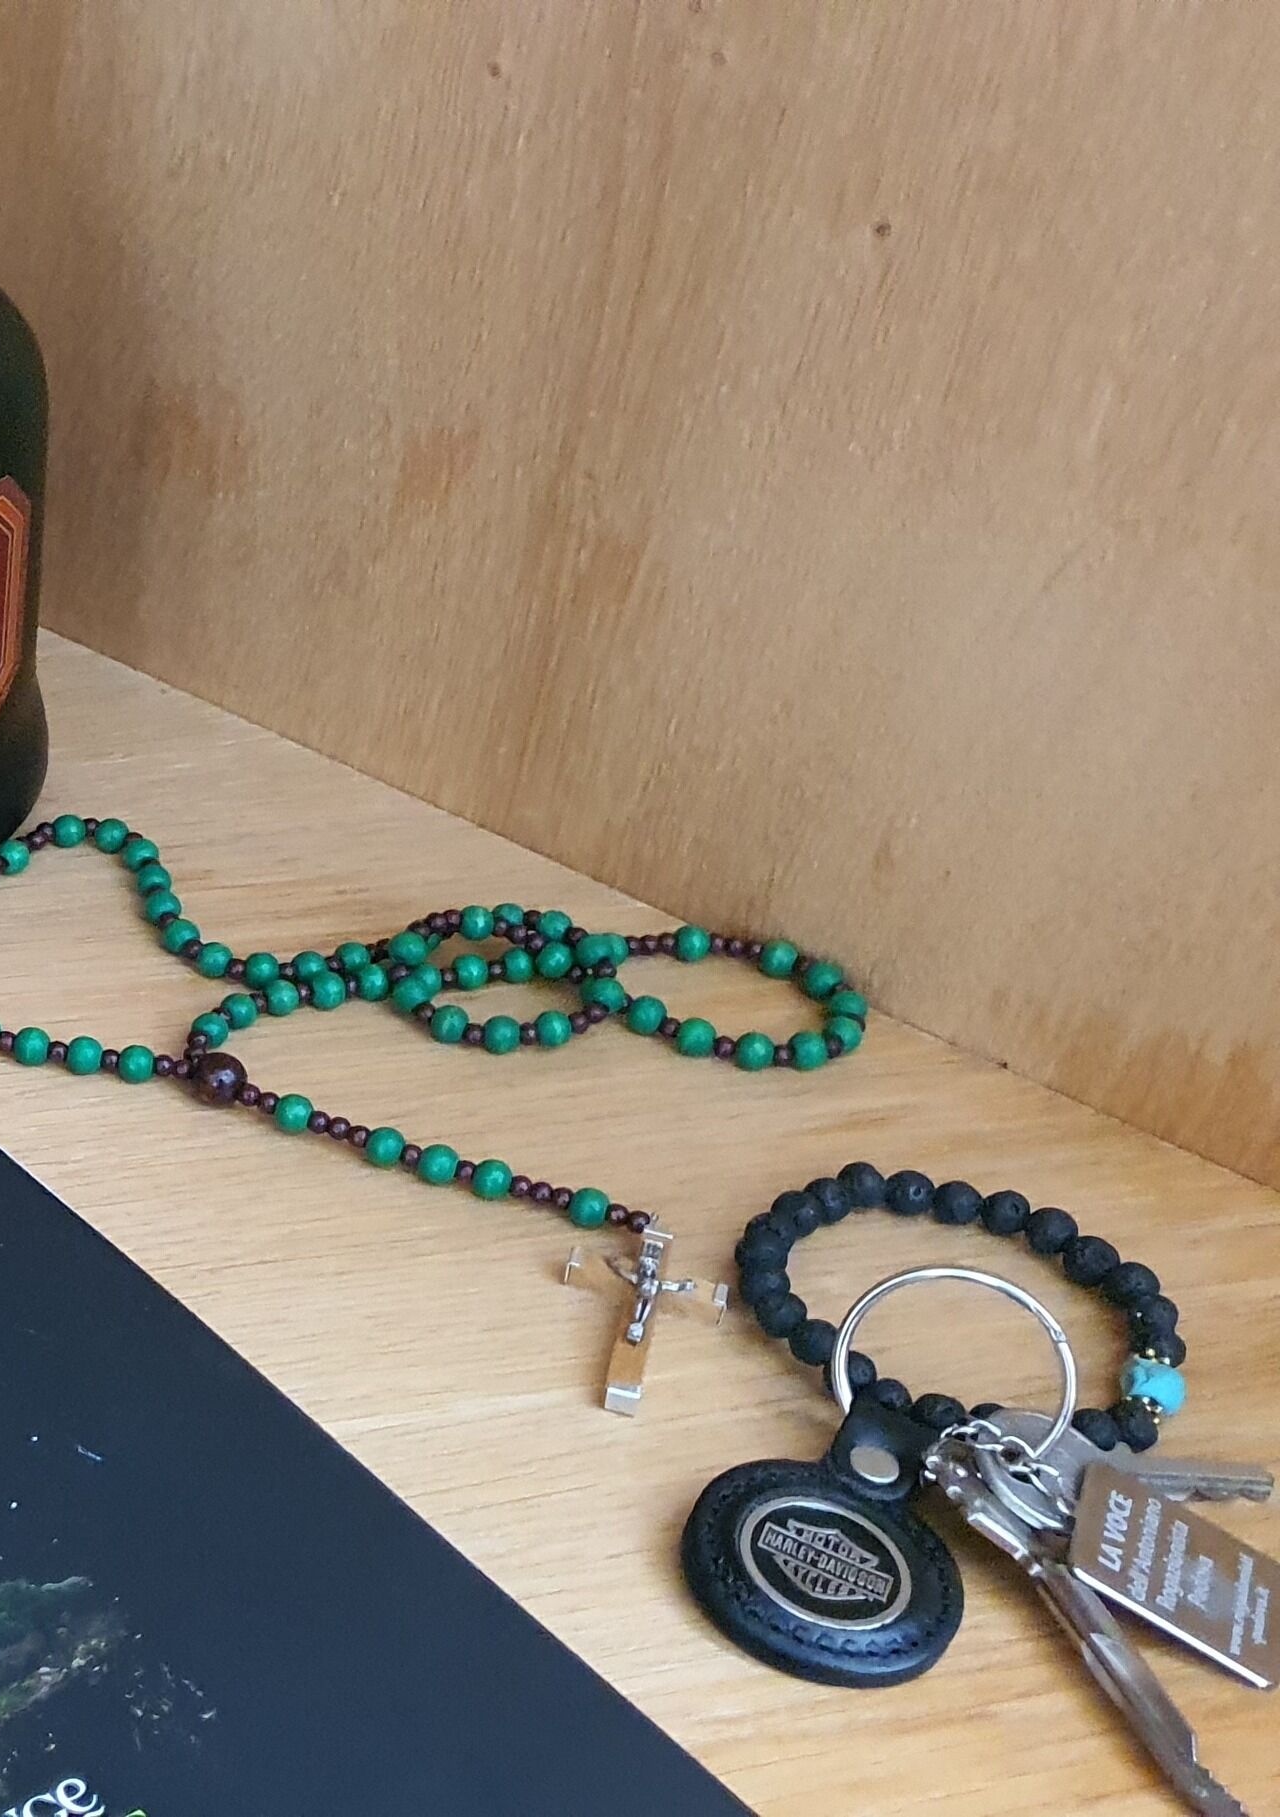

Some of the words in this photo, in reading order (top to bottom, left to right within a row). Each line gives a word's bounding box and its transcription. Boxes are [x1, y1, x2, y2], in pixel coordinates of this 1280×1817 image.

[1104, 1490, 1133, 1542] VOCE
[764, 1527, 886, 1595] HARLEY-DAVIDSON
[1097, 1543, 1123, 1572] LA
